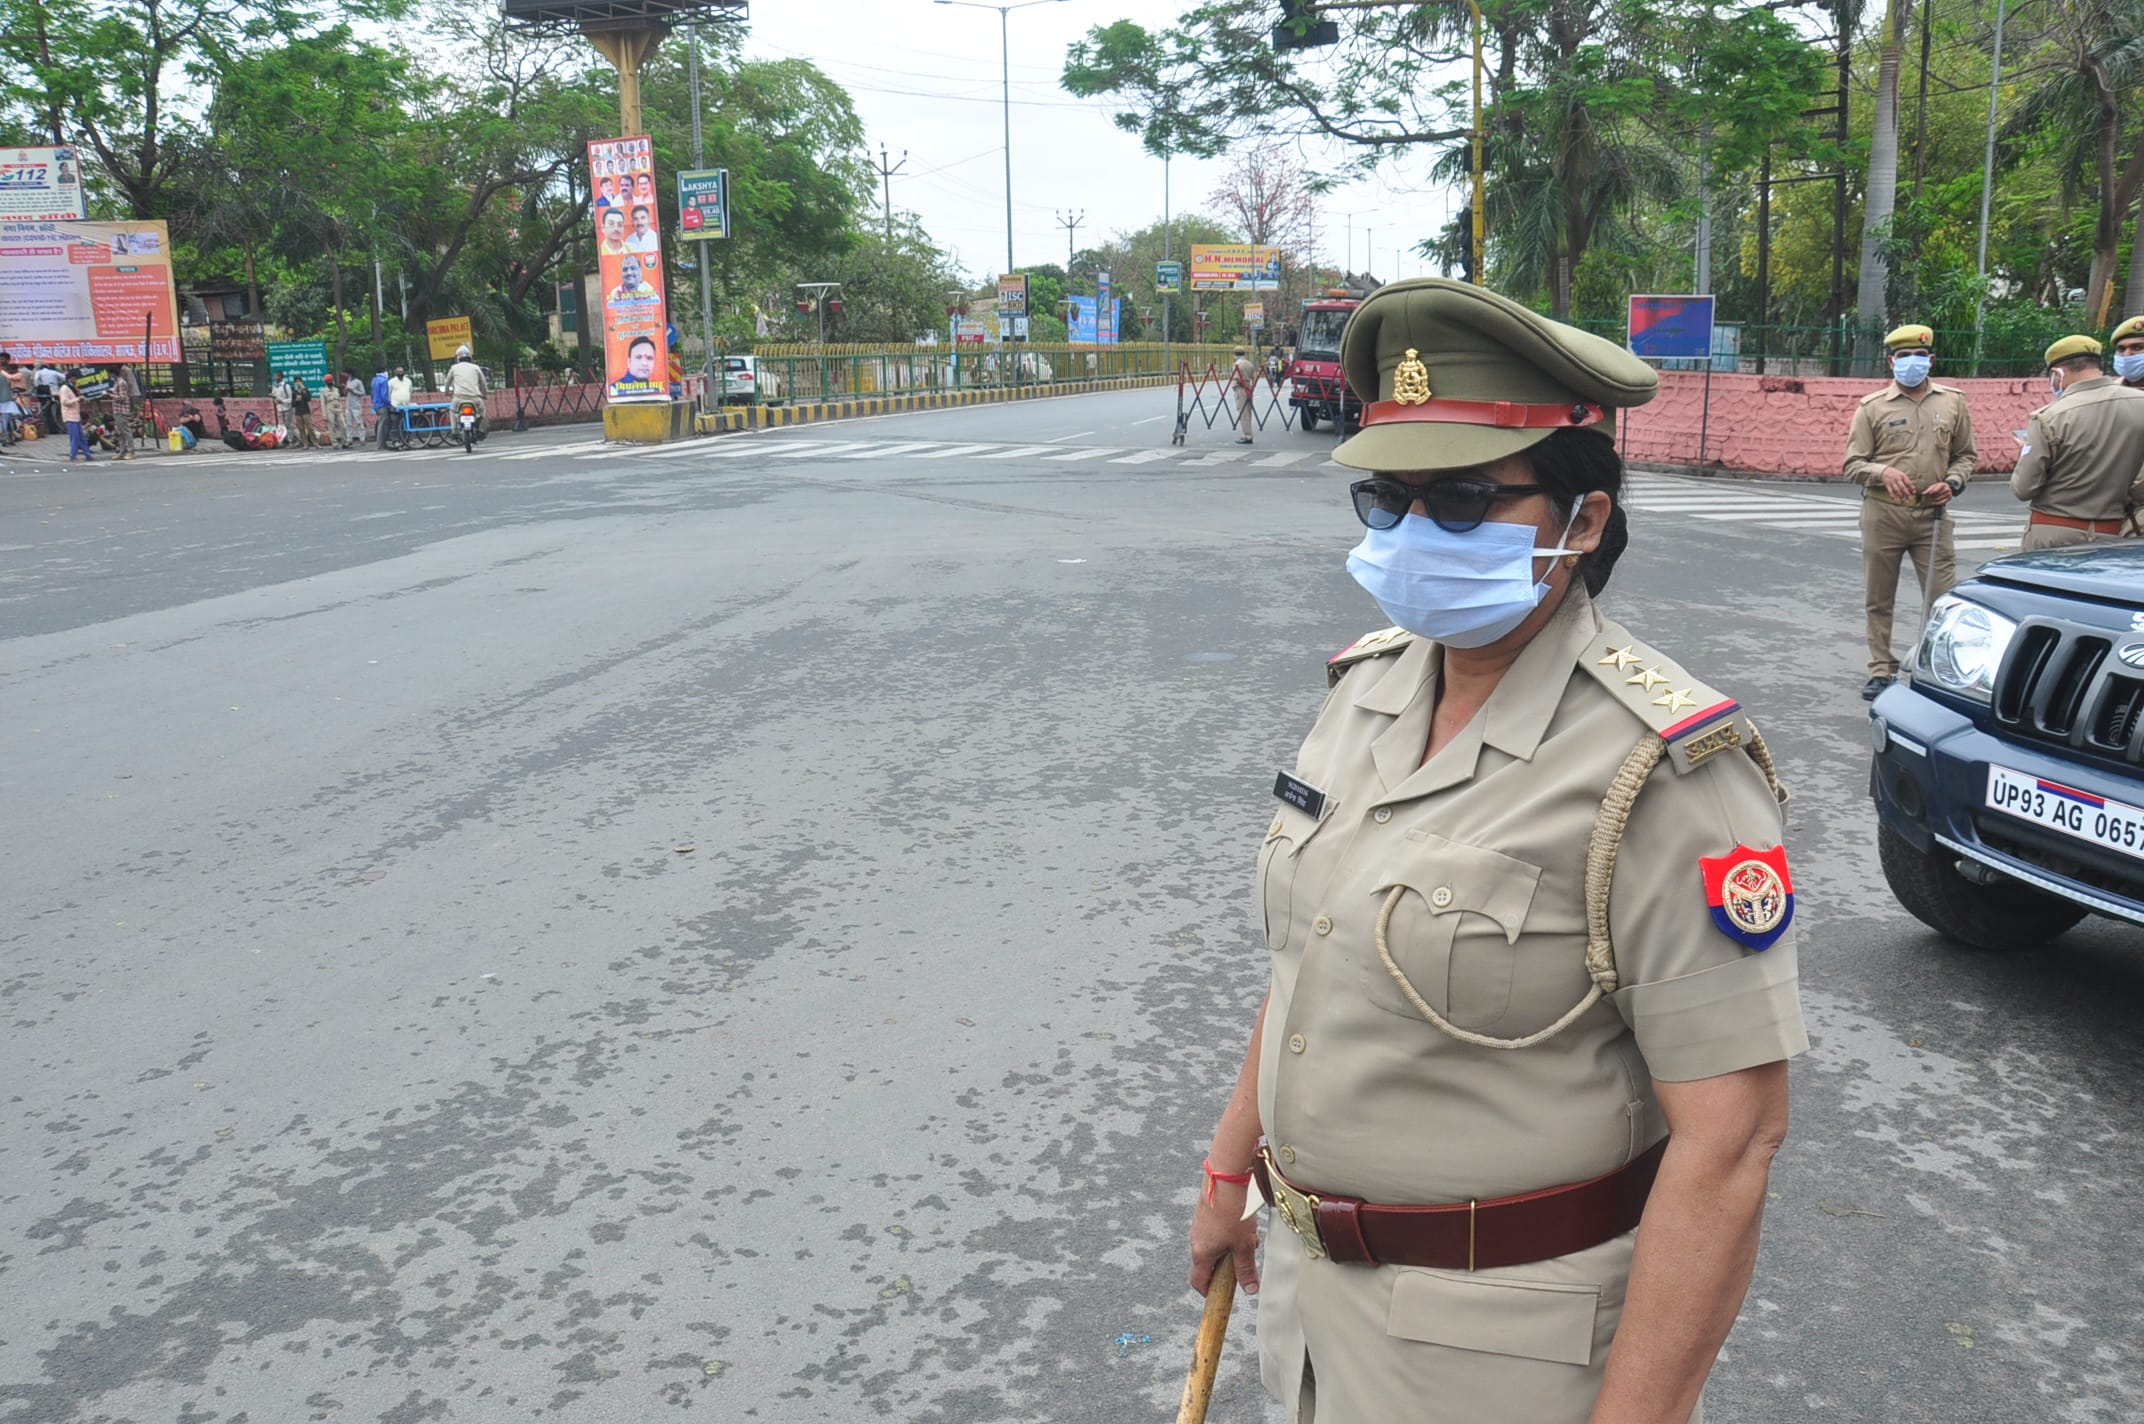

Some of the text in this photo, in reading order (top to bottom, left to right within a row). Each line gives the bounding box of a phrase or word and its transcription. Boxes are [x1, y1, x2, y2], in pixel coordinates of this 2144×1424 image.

[16, 168, 47, 180] 112
[681, 179, 718, 192] LAKSHYA
[1994, 779, 2044, 818] UP93
[2052, 800, 2083, 831] AG
